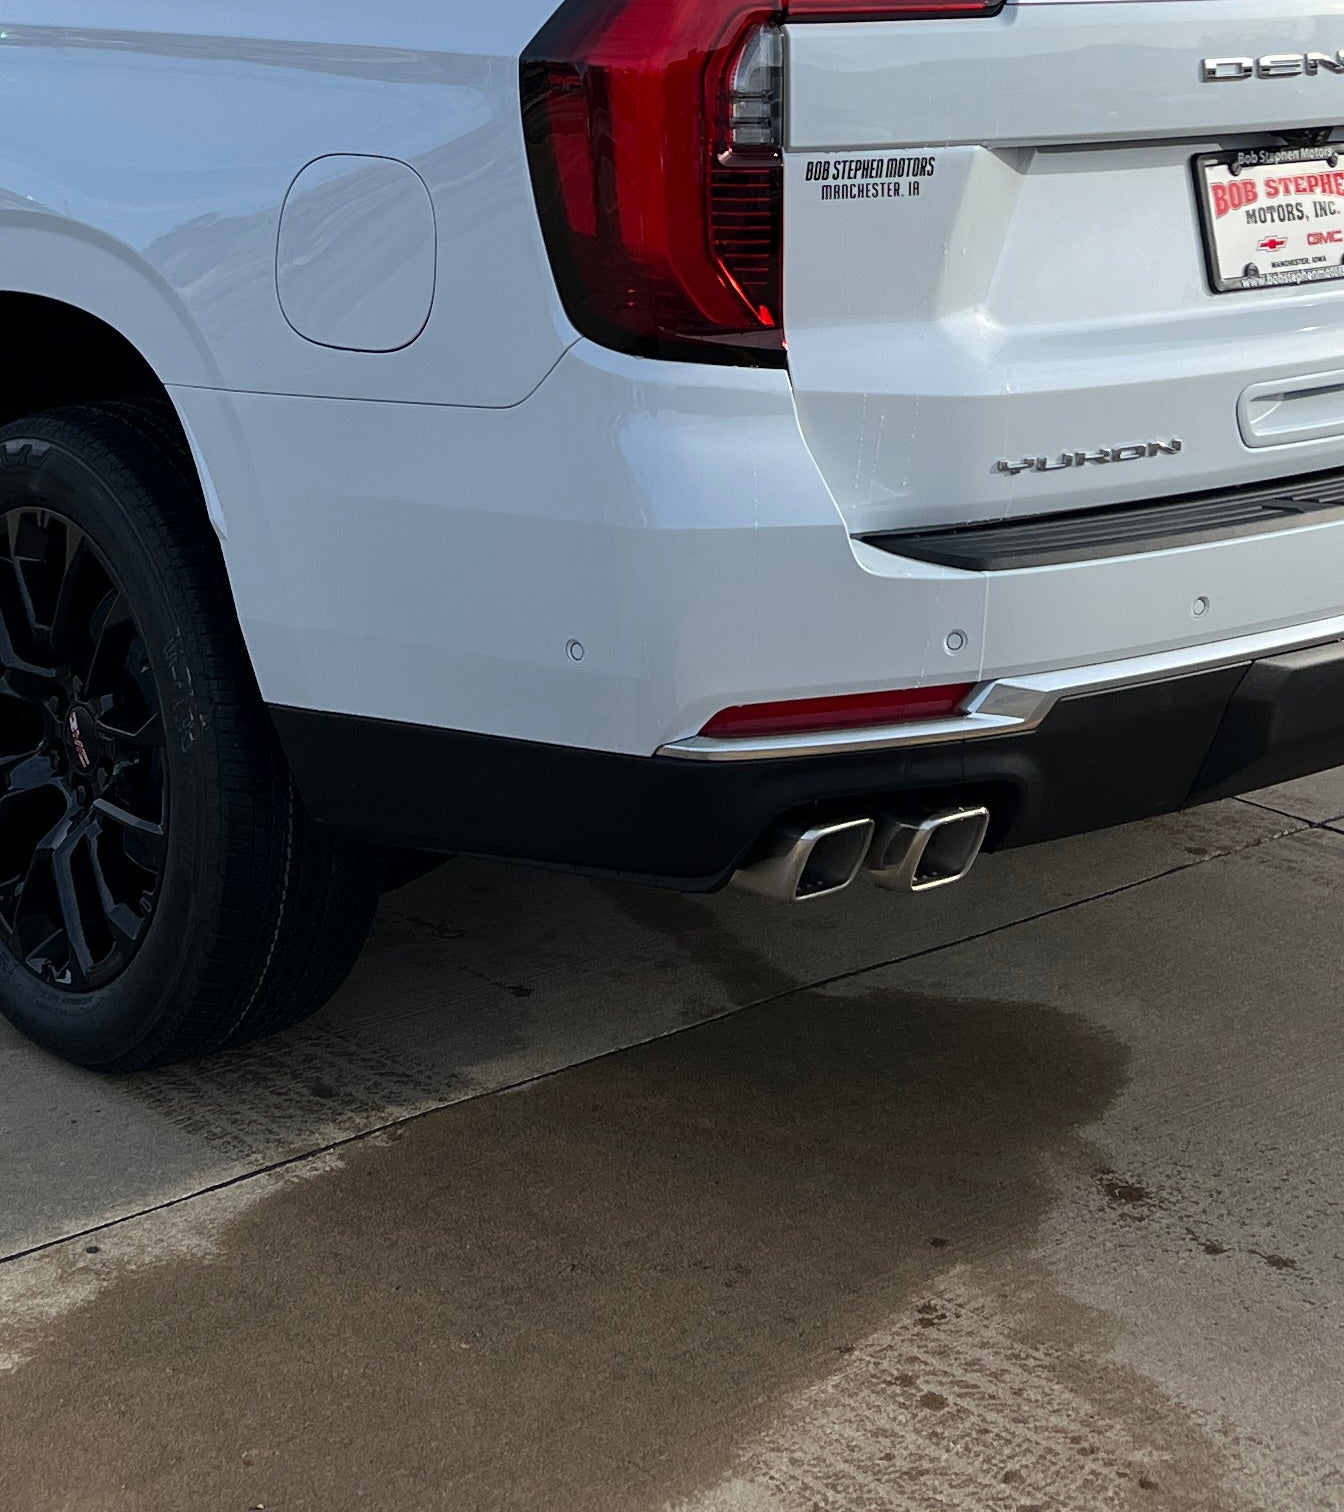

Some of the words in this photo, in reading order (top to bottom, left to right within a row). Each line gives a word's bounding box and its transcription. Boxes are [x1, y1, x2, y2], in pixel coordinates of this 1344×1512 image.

[805, 160, 830, 181] BOB
[832, 158, 884, 180] STEPHEN
[885, 156, 936, 178] MOTORS
[1237, 151, 1258, 165] Bob
[1259, 149, 1300, 165] Stephen
[1300, 147, 1334, 159] Motors
[908, 180, 920, 196] IA
[1211, 179, 1258, 220] BOB
[1245, 202, 1309, 225] MOTORS,
[1314, 200, 1341, 218] INC.
[1307, 229, 1344, 246] GMC
[994, 439, 1182, 475] YUKON
[69, 711, 90, 768] GMC
